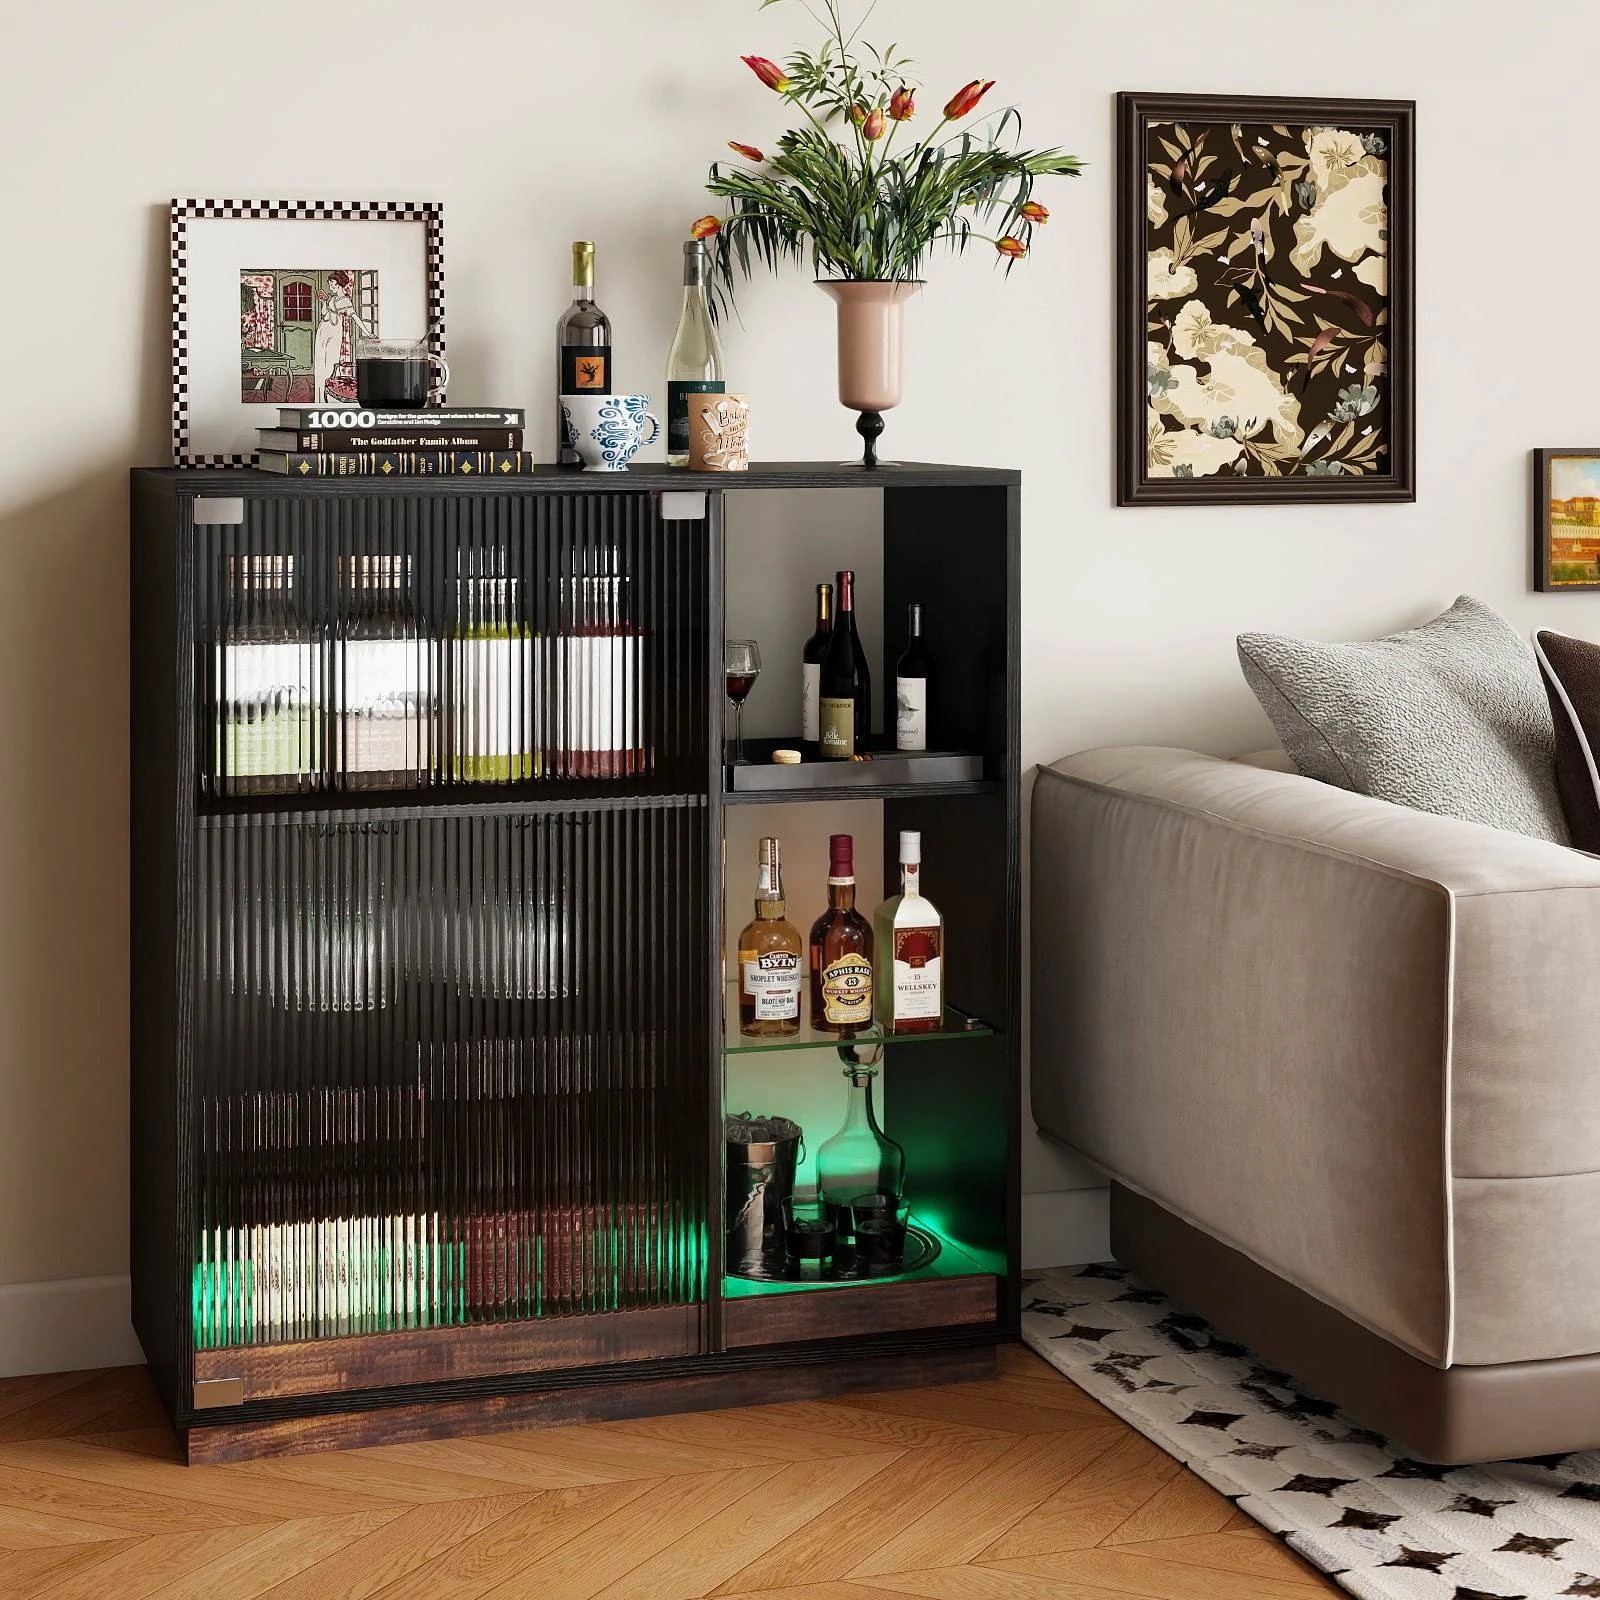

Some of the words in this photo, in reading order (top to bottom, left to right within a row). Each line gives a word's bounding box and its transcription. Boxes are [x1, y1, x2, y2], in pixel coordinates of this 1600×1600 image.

[308, 411, 376, 428] 1000
[350, 438, 369, 446] The
[370, 438, 417, 446] Godfather
[419, 438, 449, 446] Family
[450, 438, 479, 446] Album
[829, 967, 853, 979] APHIS
[854, 966, 871, 976] RASK
[848, 978, 857, 986] 13
[897, 983, 937, 991] WELLSKEY
